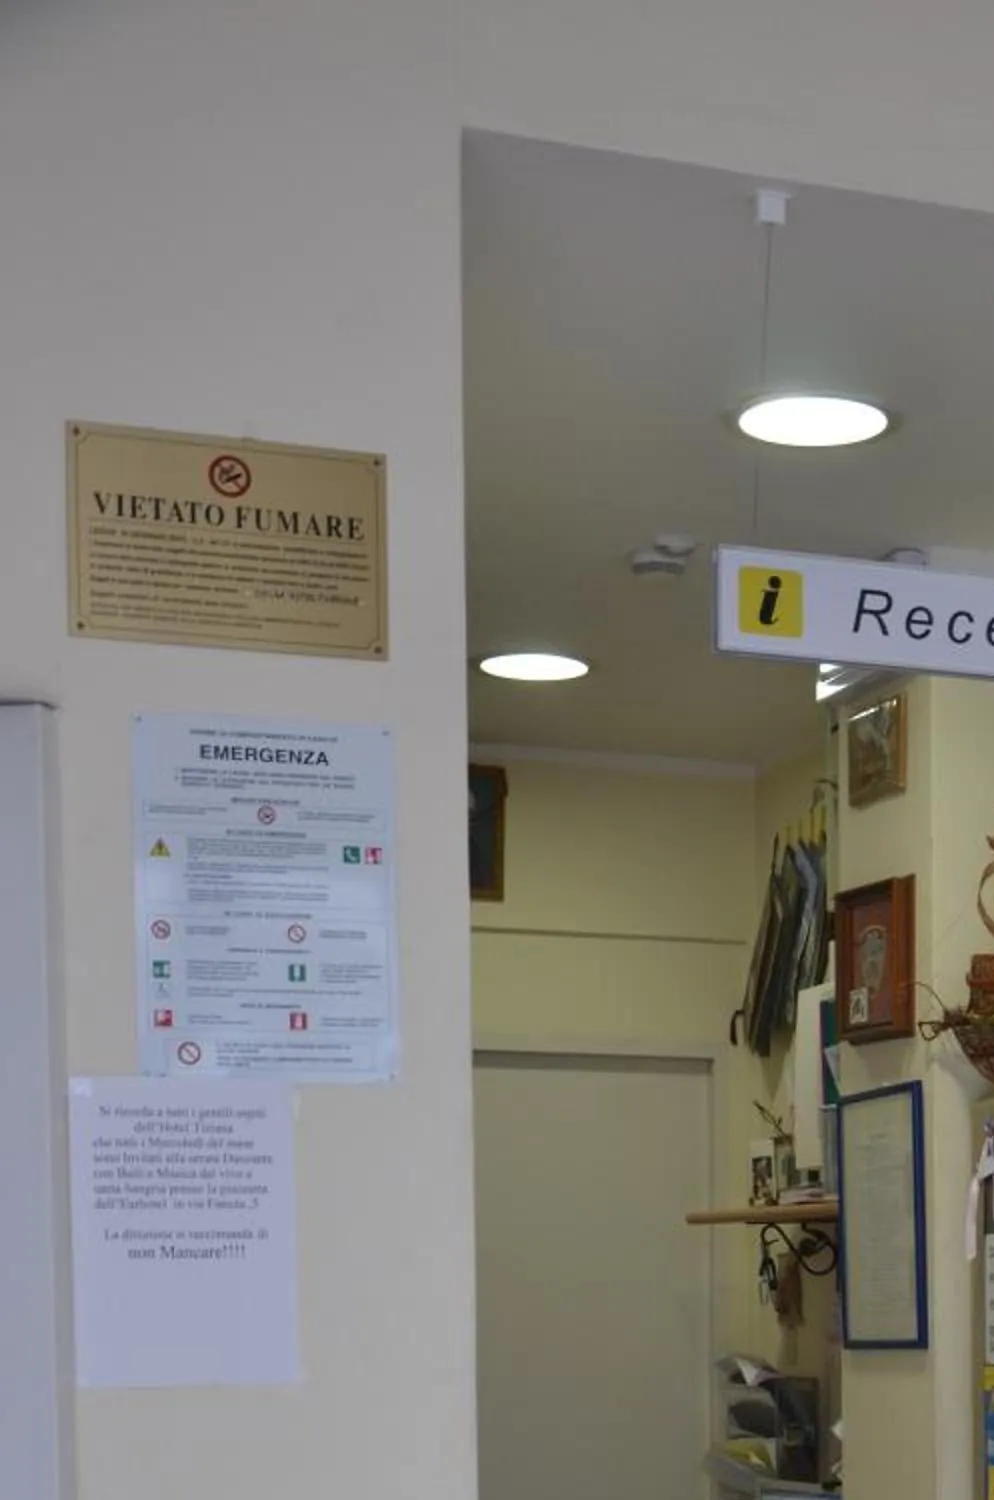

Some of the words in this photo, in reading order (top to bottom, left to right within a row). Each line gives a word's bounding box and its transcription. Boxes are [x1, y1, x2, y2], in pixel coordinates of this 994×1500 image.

[93, 491, 226, 527] VIETATO
[235, 506, 366, 541] FUMARE
[199, 744, 330, 767] EMERGENZA
[127, 1247, 155, 1260] non
